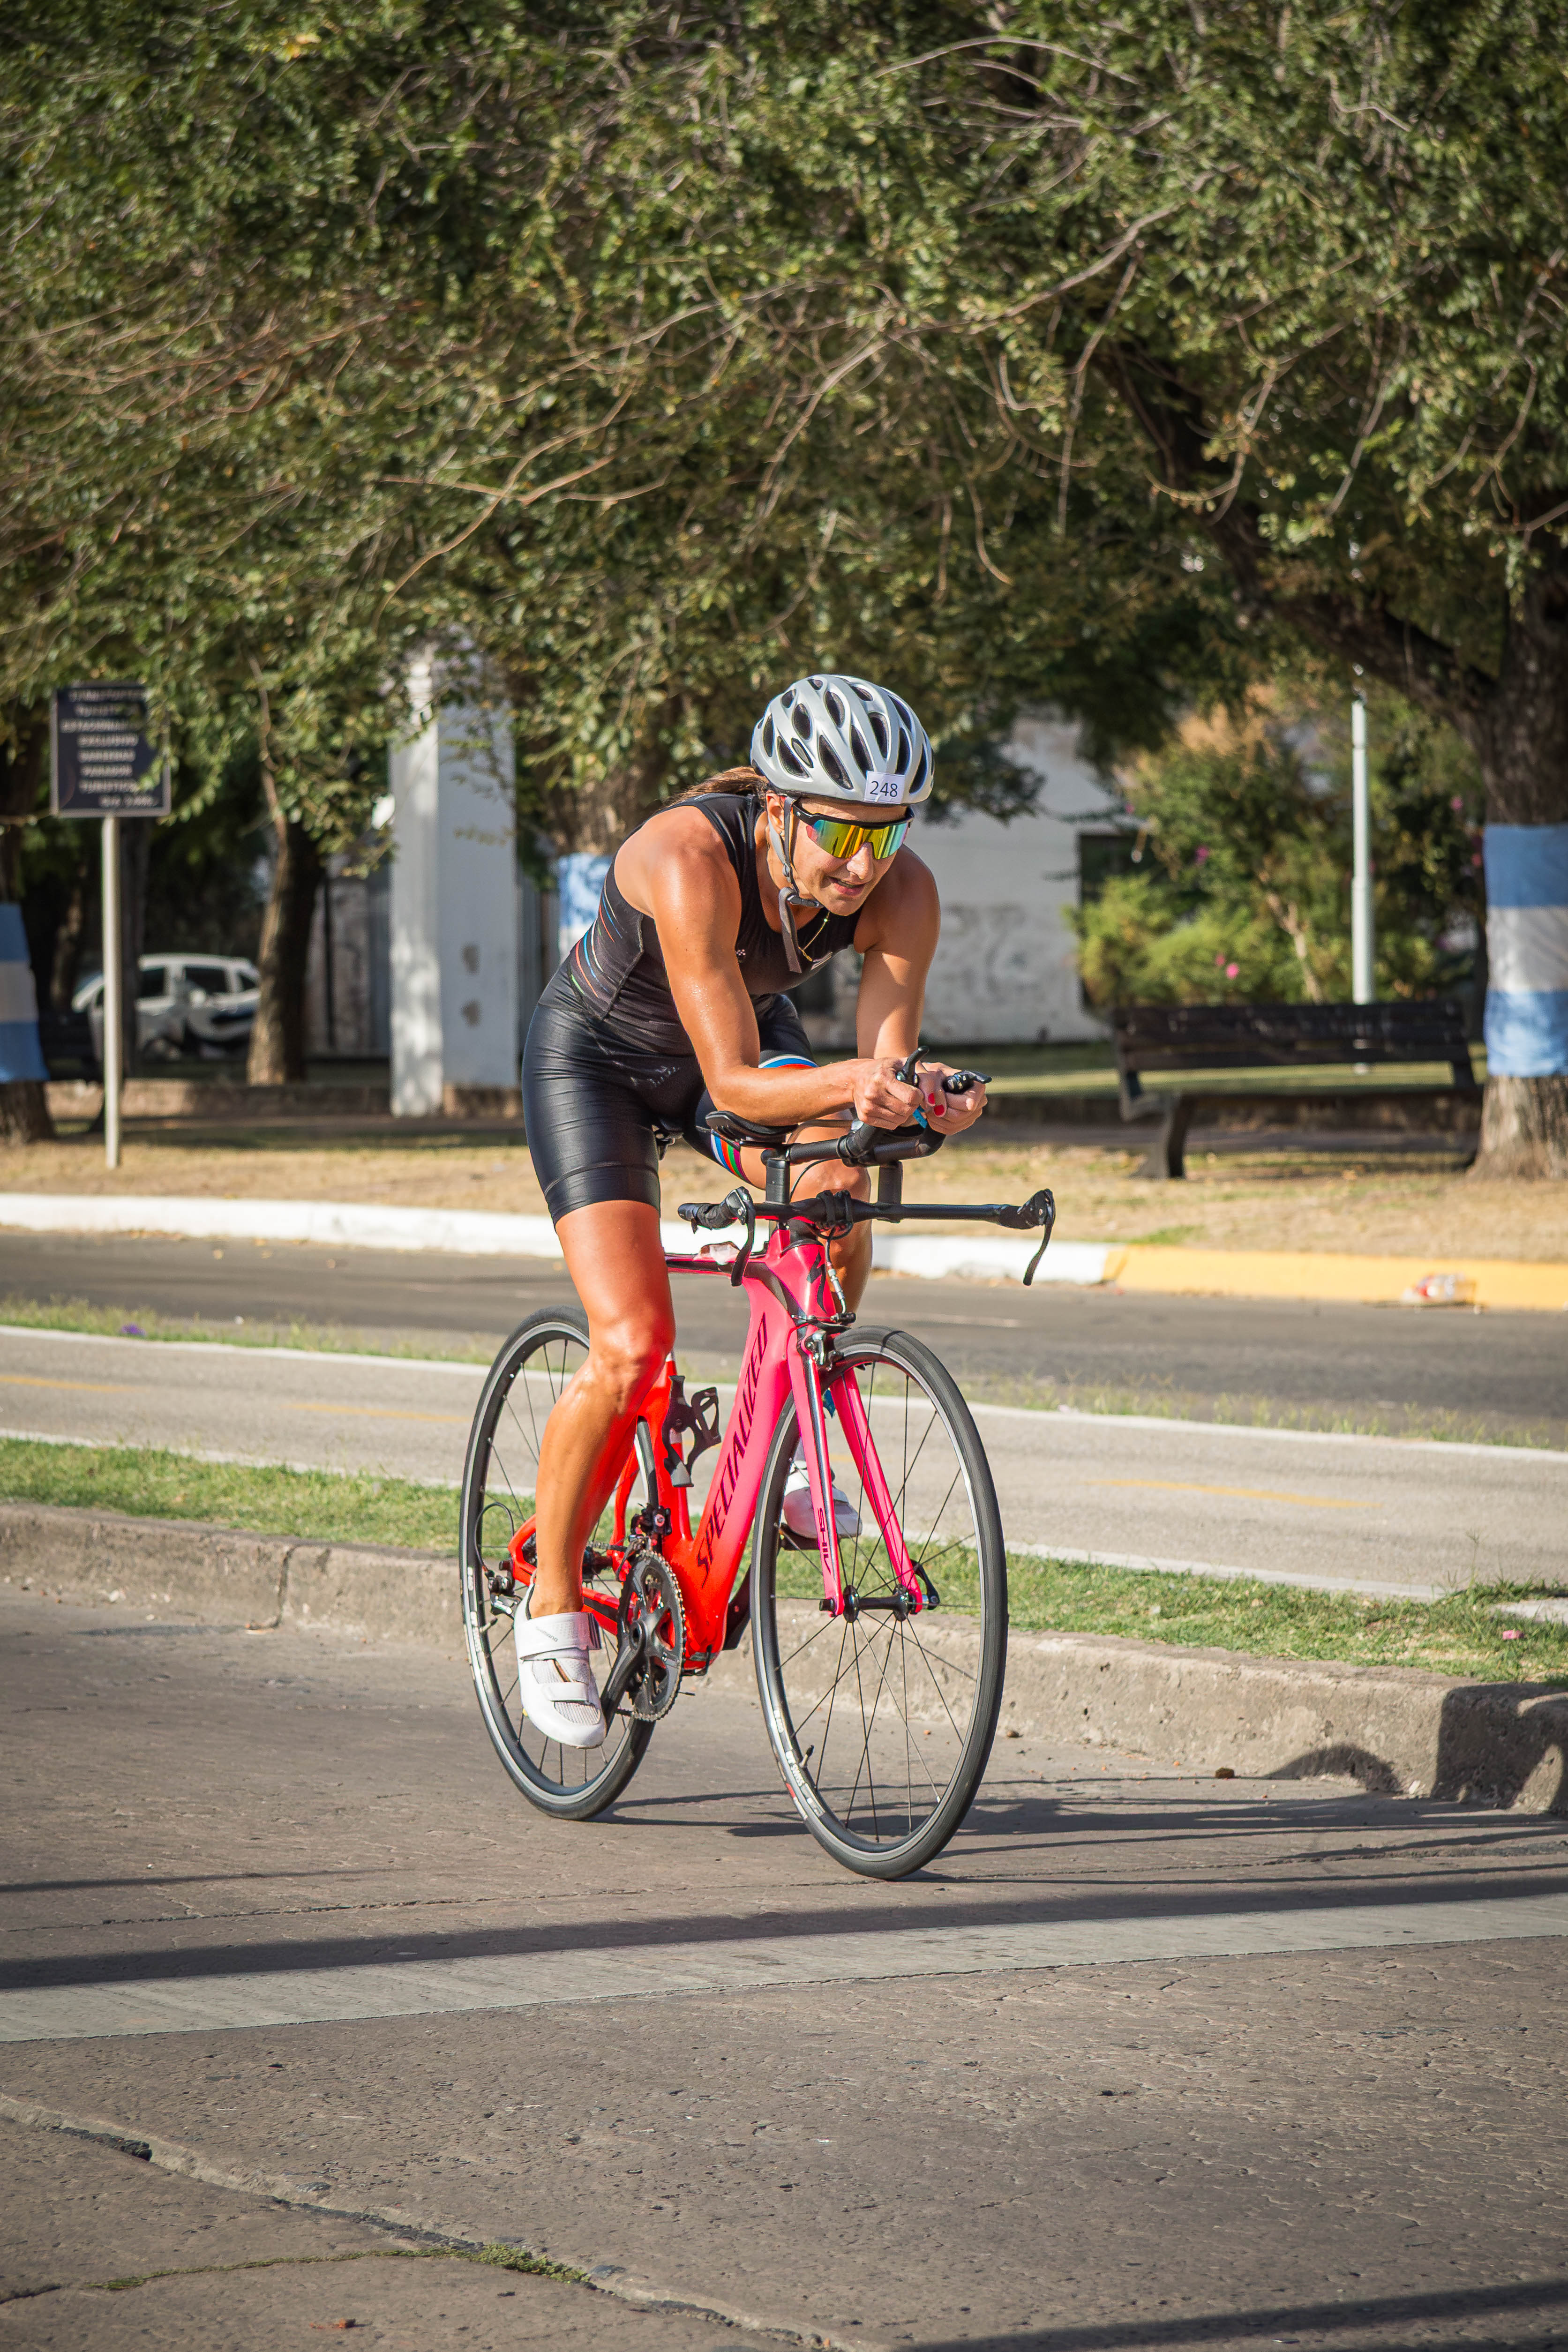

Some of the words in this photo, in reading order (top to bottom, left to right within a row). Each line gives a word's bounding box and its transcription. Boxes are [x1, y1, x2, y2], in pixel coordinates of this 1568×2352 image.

[870, 781, 898, 797] 248
[697, 1312, 768, 1588] SPECIALIZED
[536, 1626, 558, 1642] MANO
